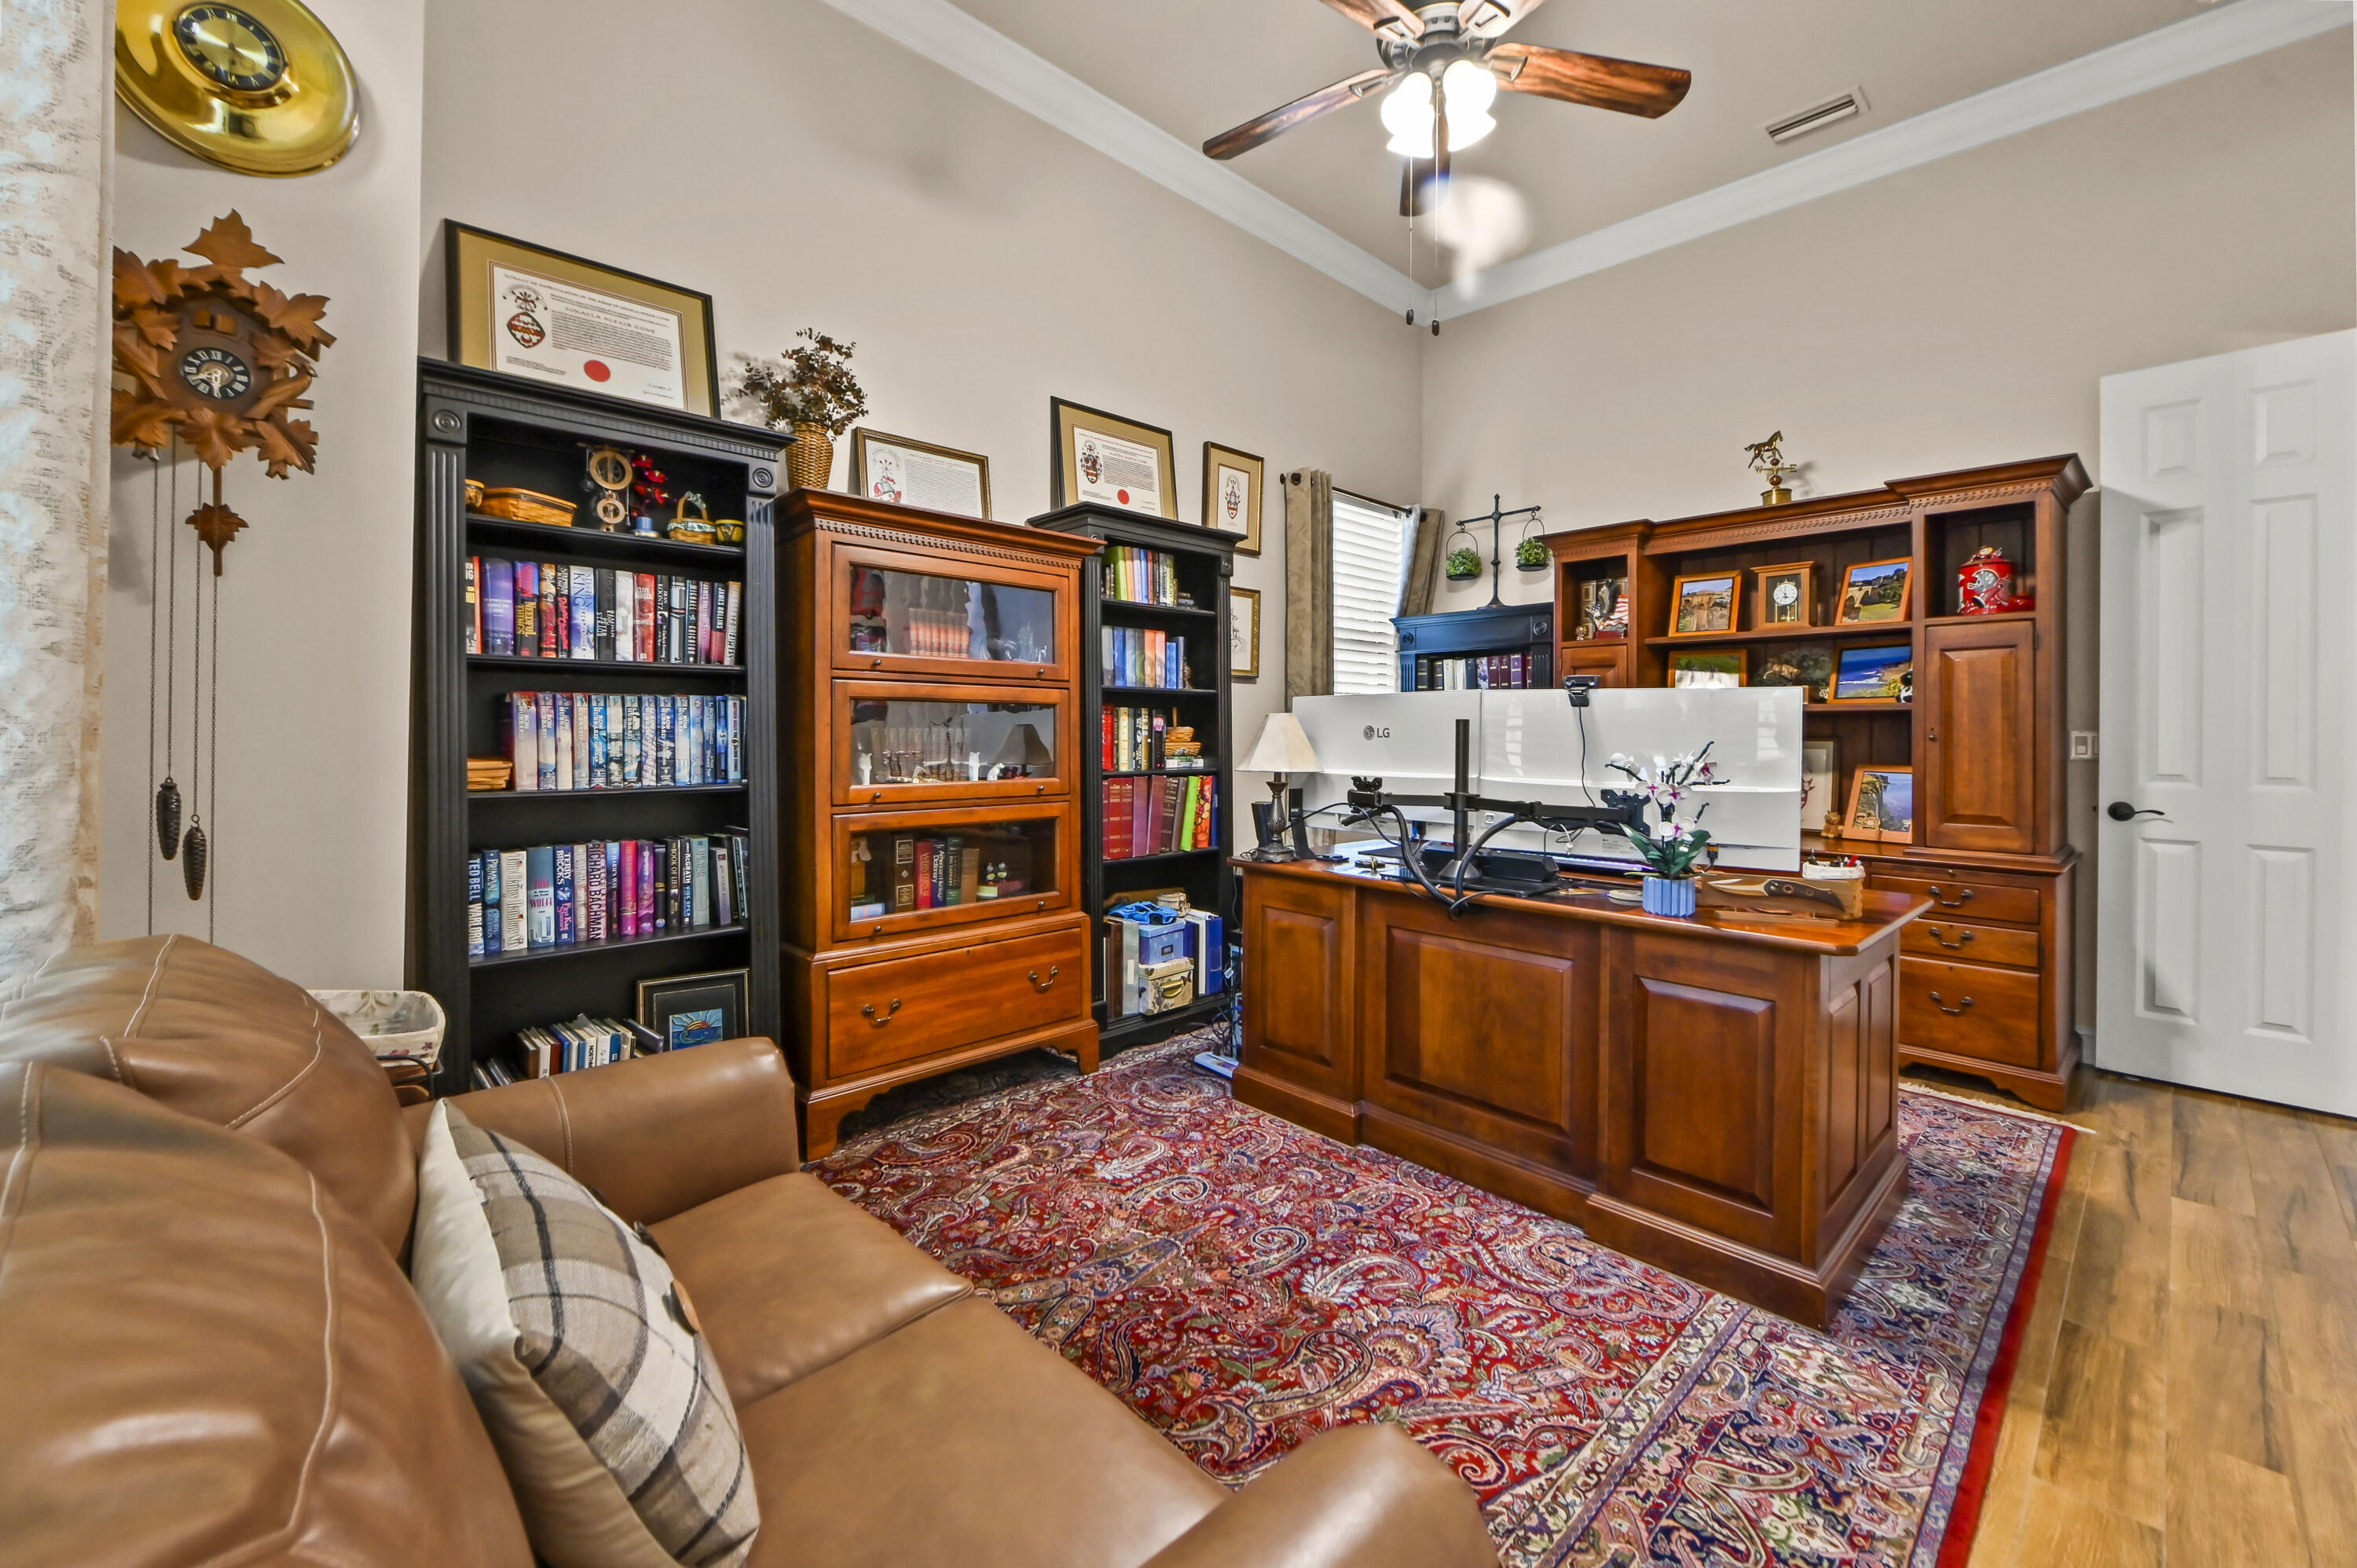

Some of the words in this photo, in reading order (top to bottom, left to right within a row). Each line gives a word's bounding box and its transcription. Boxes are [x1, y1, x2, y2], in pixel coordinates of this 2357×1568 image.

[574, 573, 586, 606] KING
[689, 584, 698, 610] MICHAEL
[515, 605, 525, 635] THINGS
[525, 601, 537, 636] NEEDFUL
[729, 599, 738, 625] KOONTZ
[687, 625, 696, 654] CRICHTON
[727, 625, 737, 661] BREATHLESS
[1376, 727, 1390, 738] LG
[468, 858, 481, 876] TED
[486, 859, 499, 892] PRIMEVAL
[556, 850, 565, 885] BROOKS
[588, 844, 601, 887] RICHARD
[468, 877, 482, 901] BELL
[468, 903, 483, 944] WARLORD
[588, 890, 601, 940] BACHMAN
